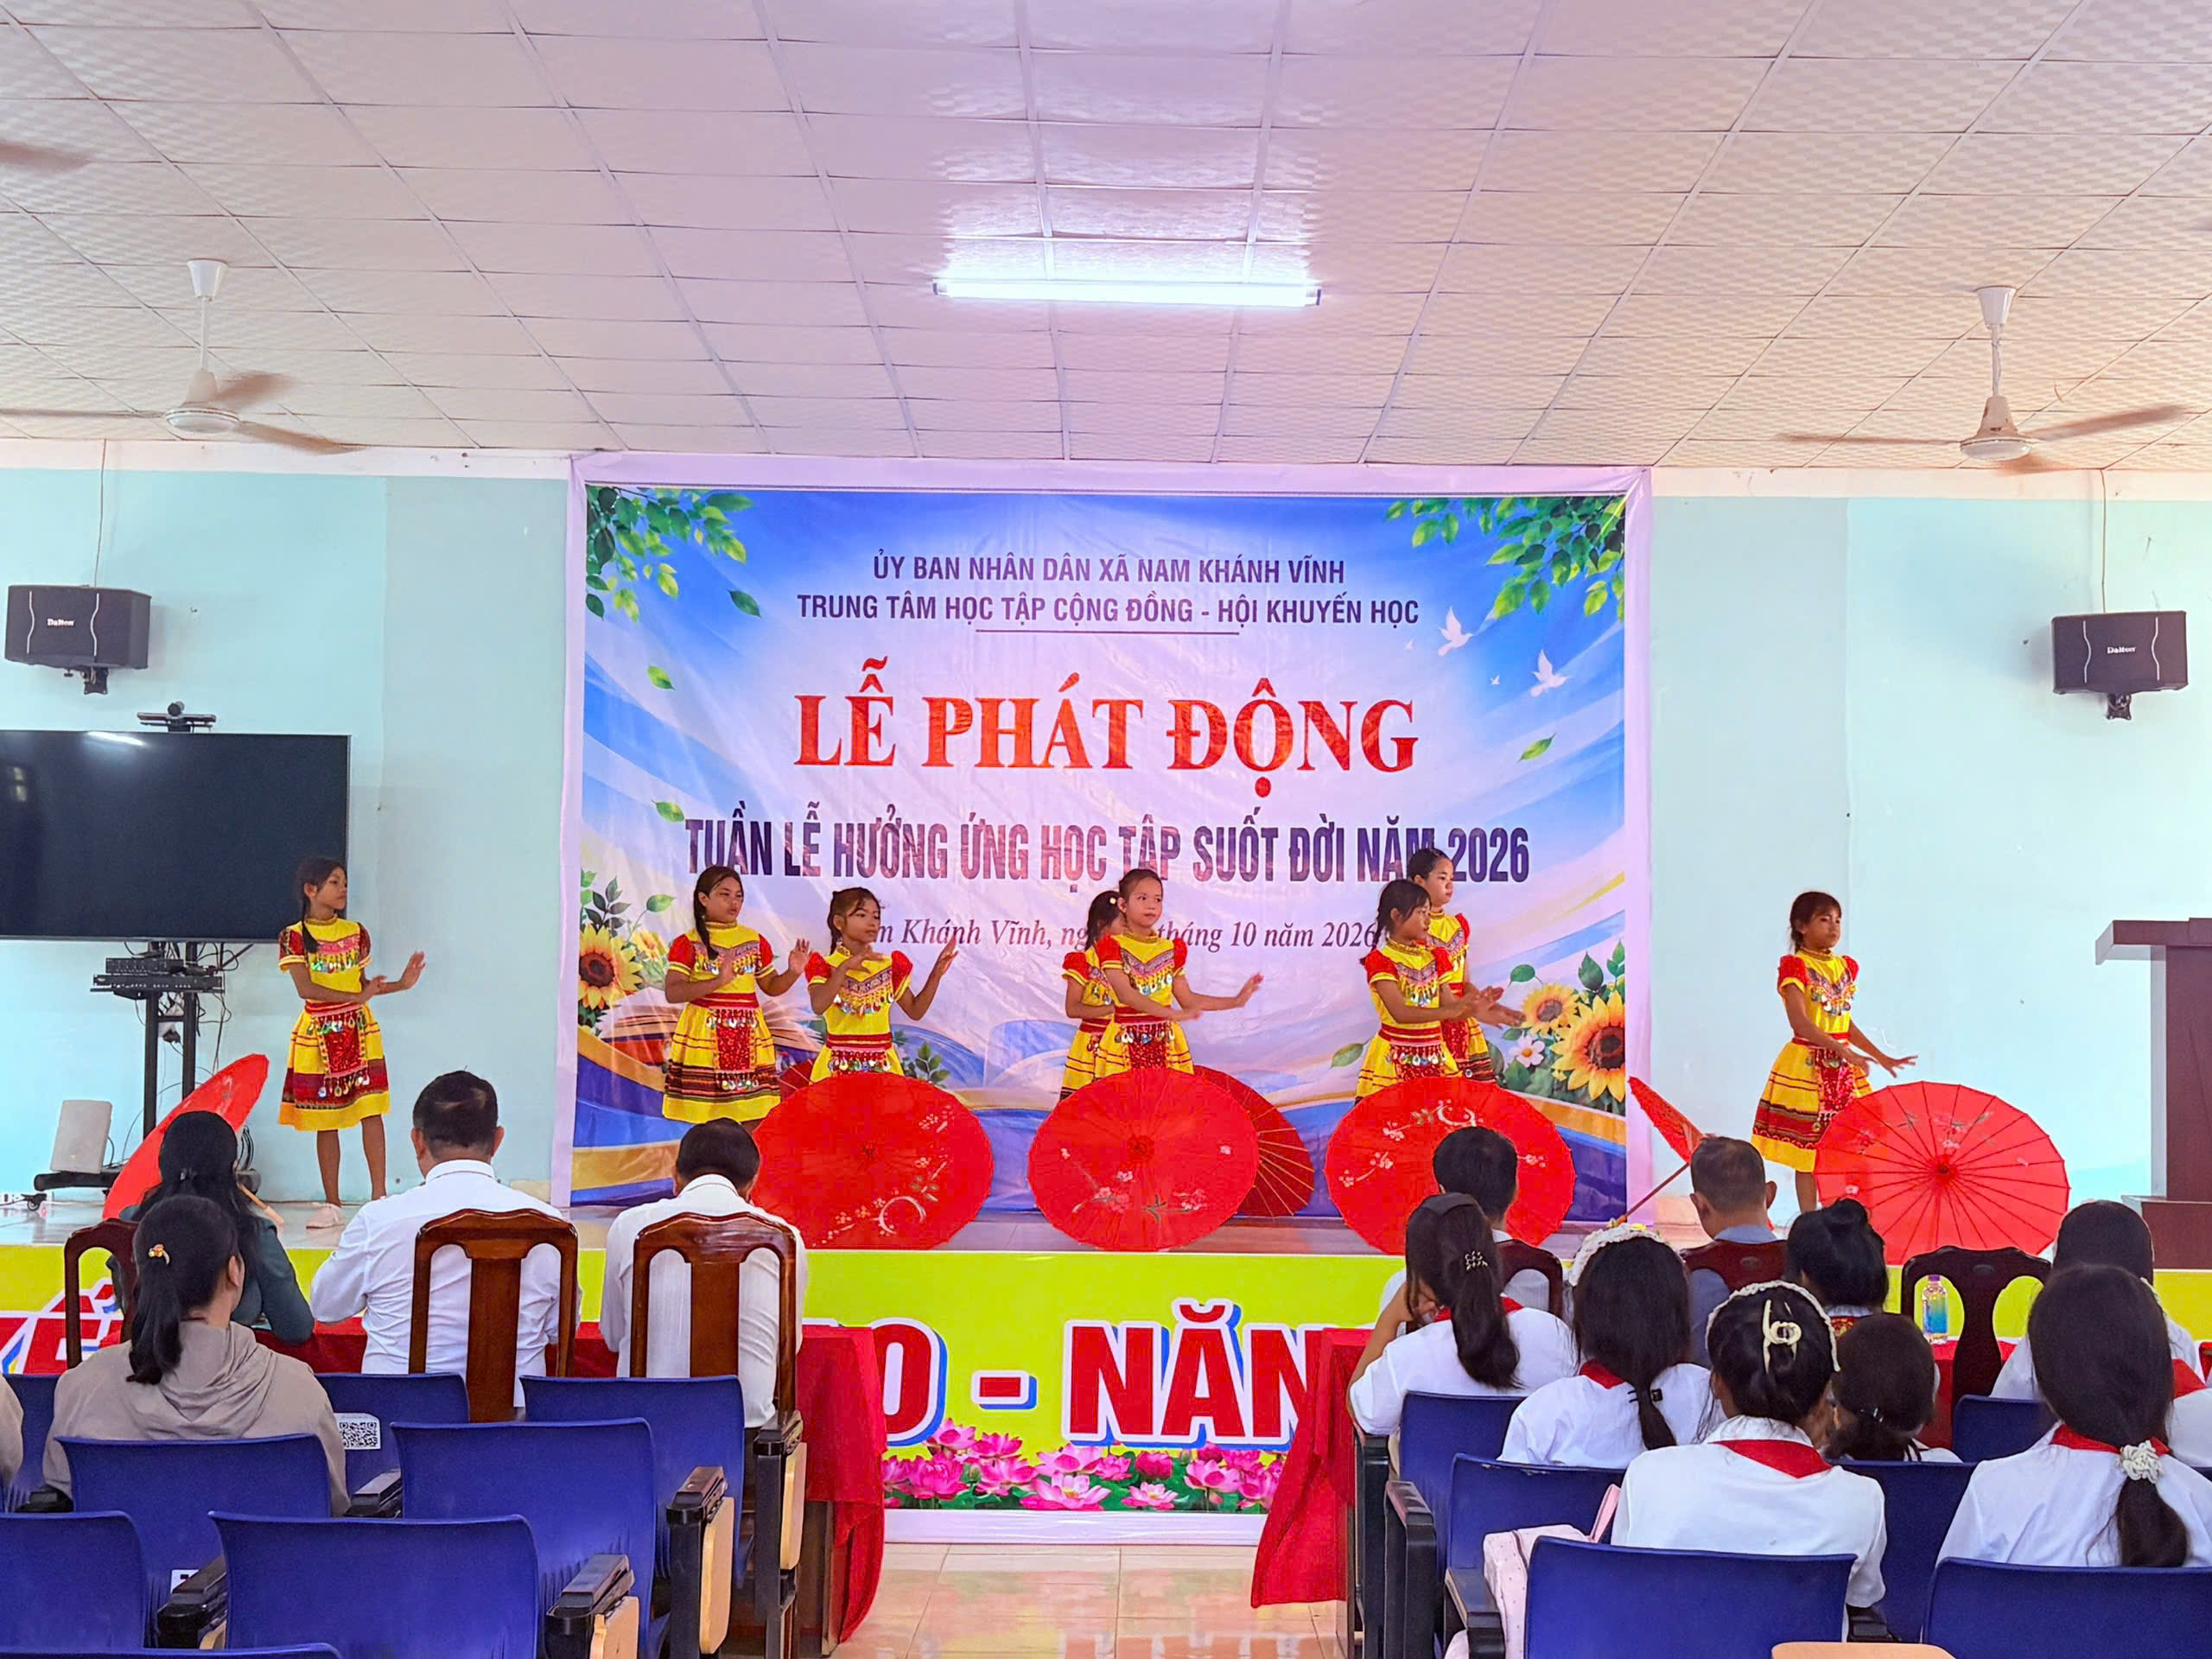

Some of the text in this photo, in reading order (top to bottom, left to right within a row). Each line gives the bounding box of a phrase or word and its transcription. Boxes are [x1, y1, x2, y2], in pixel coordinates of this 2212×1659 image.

[874, 549, 1344, 583] ỦY BAN NHÂN DÂN XÃ NAM KHÁNH VĨNH
[798, 594, 878, 619] TRUNG
[887, 590, 936, 619] TÂM
[945, 596, 994, 625] HỌC
[1001, 592, 1046, 626] TẬP
[1053, 593, 1118, 626] CỘNG
[1126, 590, 1192, 622] ĐỒNG
[1218, 594, 1257, 628] HỘI
[1267, 592, 1362, 624] KHUYẾN
[1370, 600, 1419, 628] HỌC
[793, 655, 1419, 798] LỄ PHÁT ĐỘNG
[685, 800, 772, 876] TUẦN
[784, 801, 821, 876] LỄ
[833, 804, 948, 879] HƯỞNG
[960, 812, 1029, 880] ỨNG
[1040, 824, 1107, 893] HỌC
[1192, 807, 1280, 882] SUỐT
[1288, 812, 1344, 882] ĐỜI
[1448, 827, 1529, 882] 2026
[900, 918, 981, 944] Khánh
[991, 919, 1052, 950] Vĩnh,
[1230, 921, 1257, 947] 10
[1263, 922, 1313, 947] năm
[1321, 921, 1377, 947] 2026
[1064, 1298, 1326, 1450] NĂN
